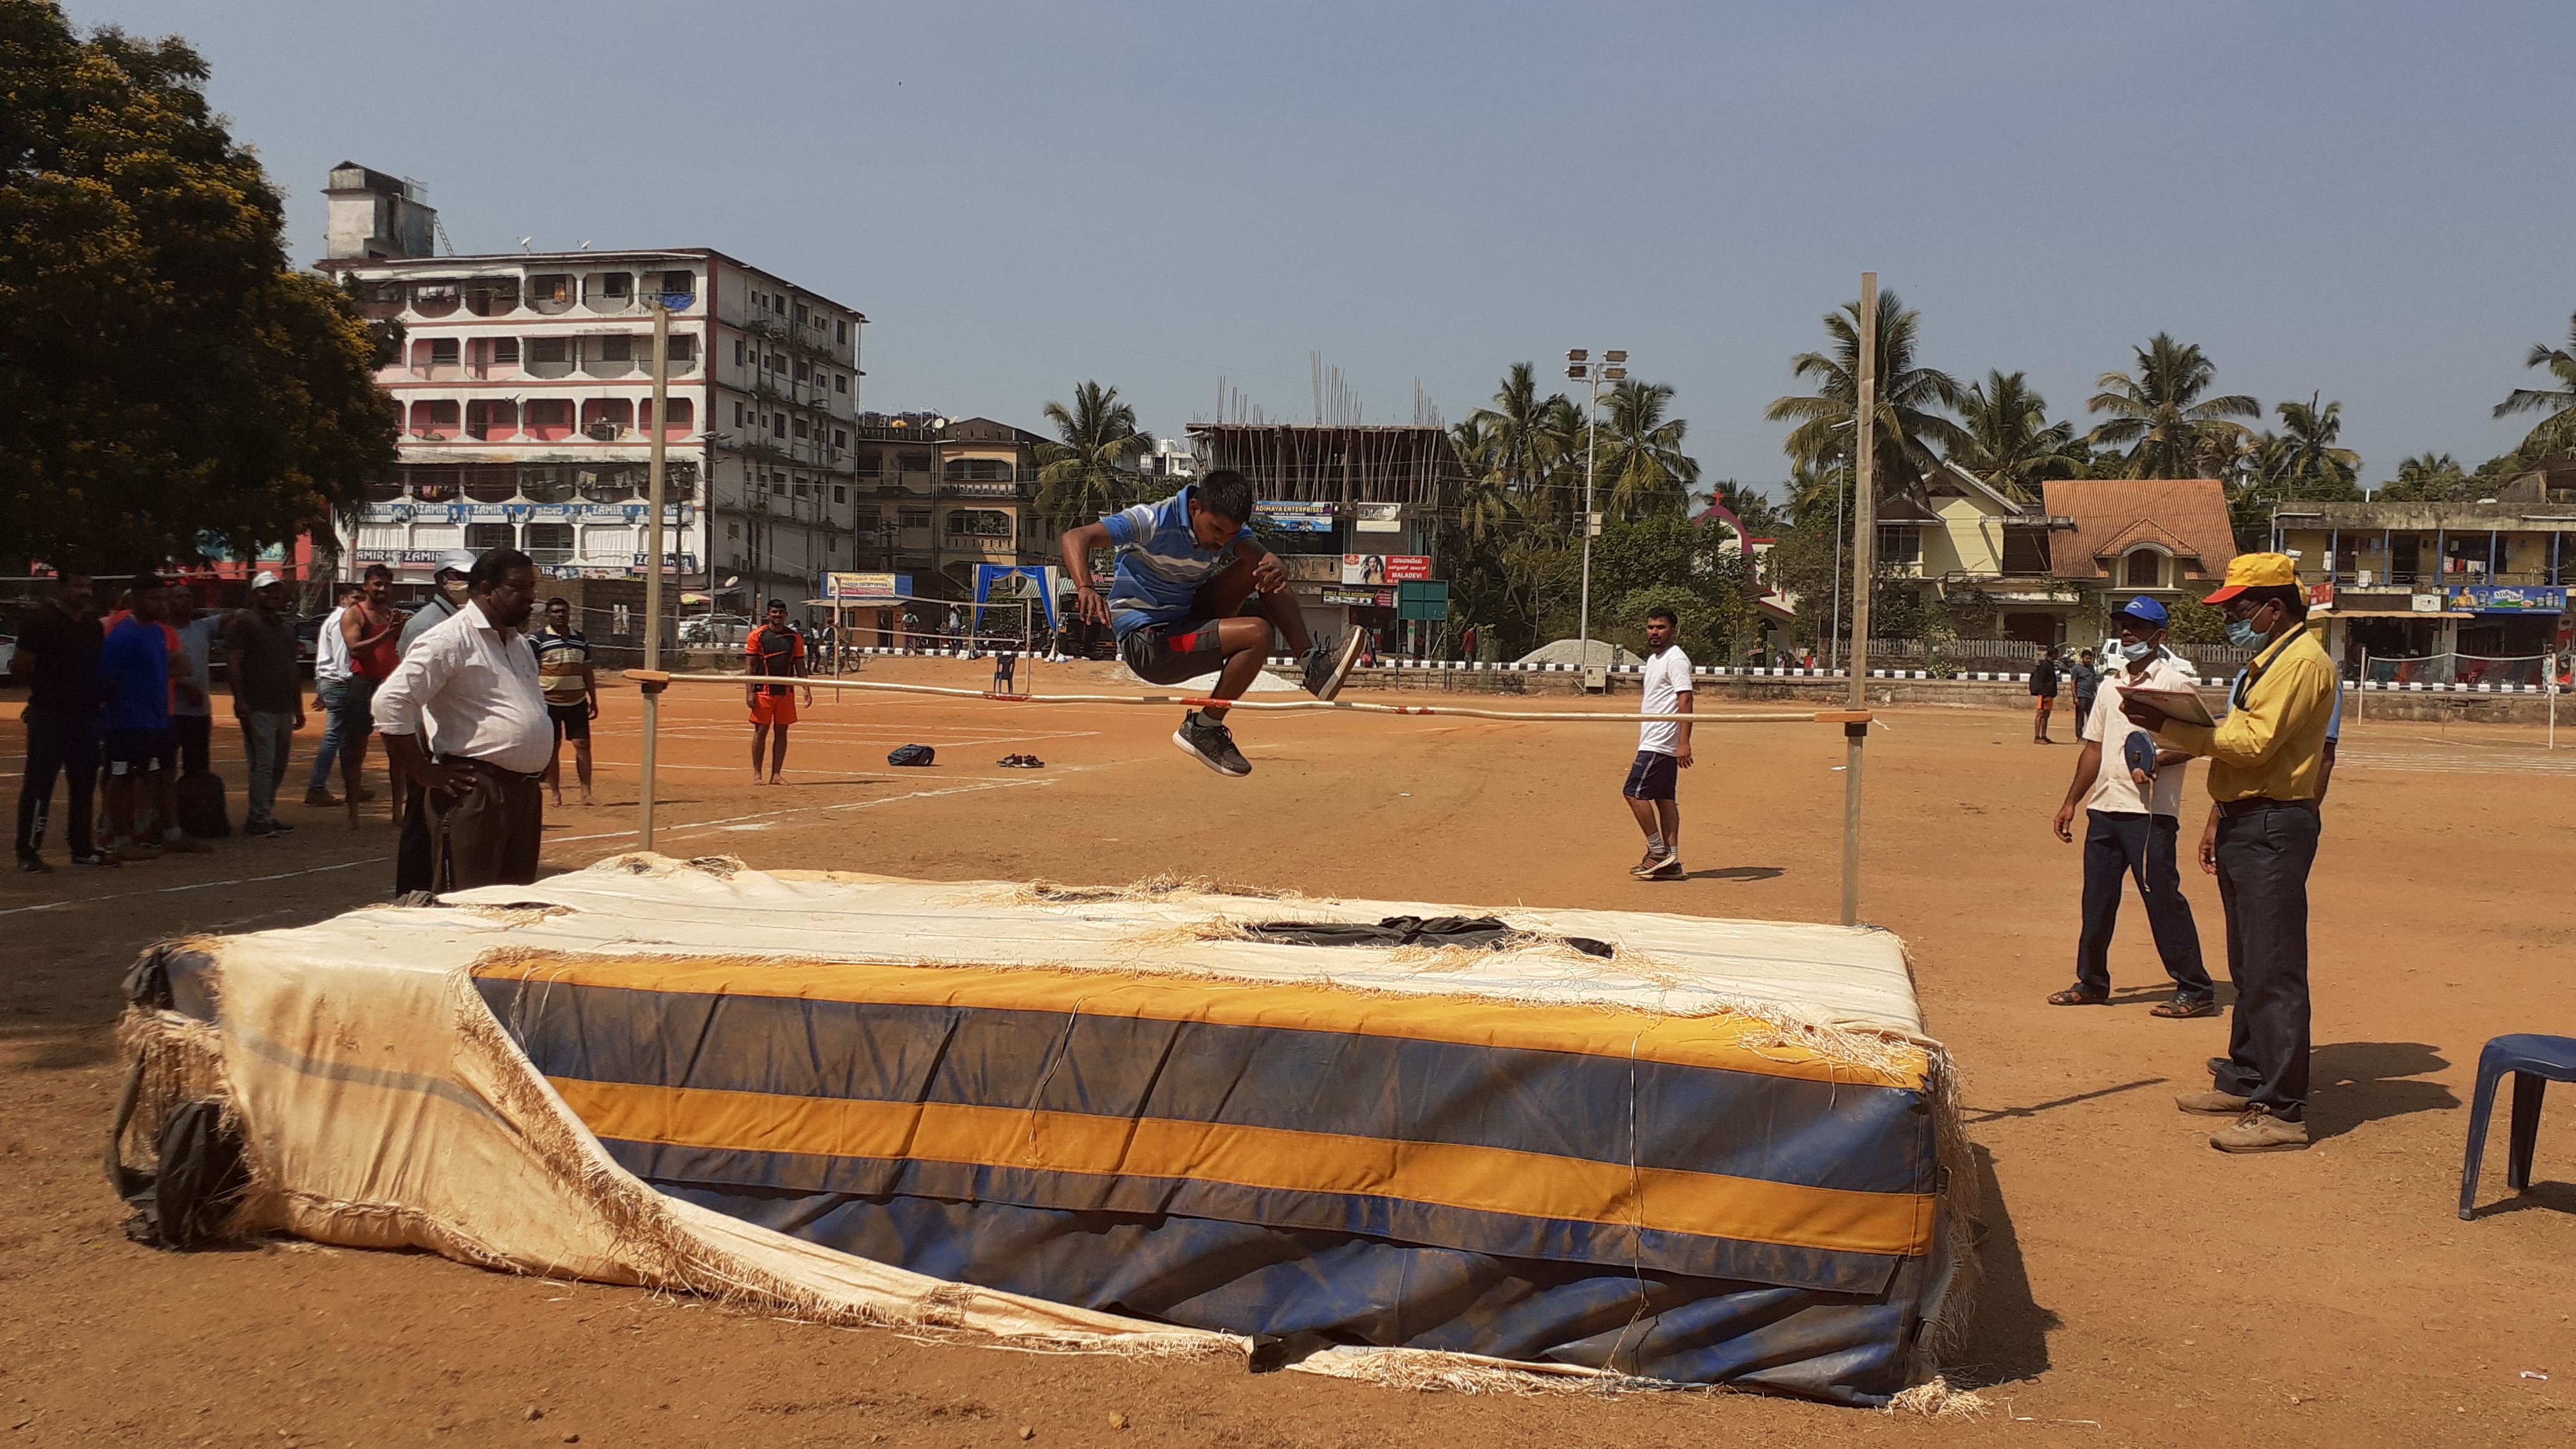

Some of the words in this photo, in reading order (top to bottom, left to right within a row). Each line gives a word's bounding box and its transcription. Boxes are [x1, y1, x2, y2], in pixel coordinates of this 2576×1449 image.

[419, 505, 449, 514] ZAMIR
[473, 505, 503, 515] ZAMIR
[592, 505, 623, 515] ZAMIR
[356, 551, 384, 561] AMIR
